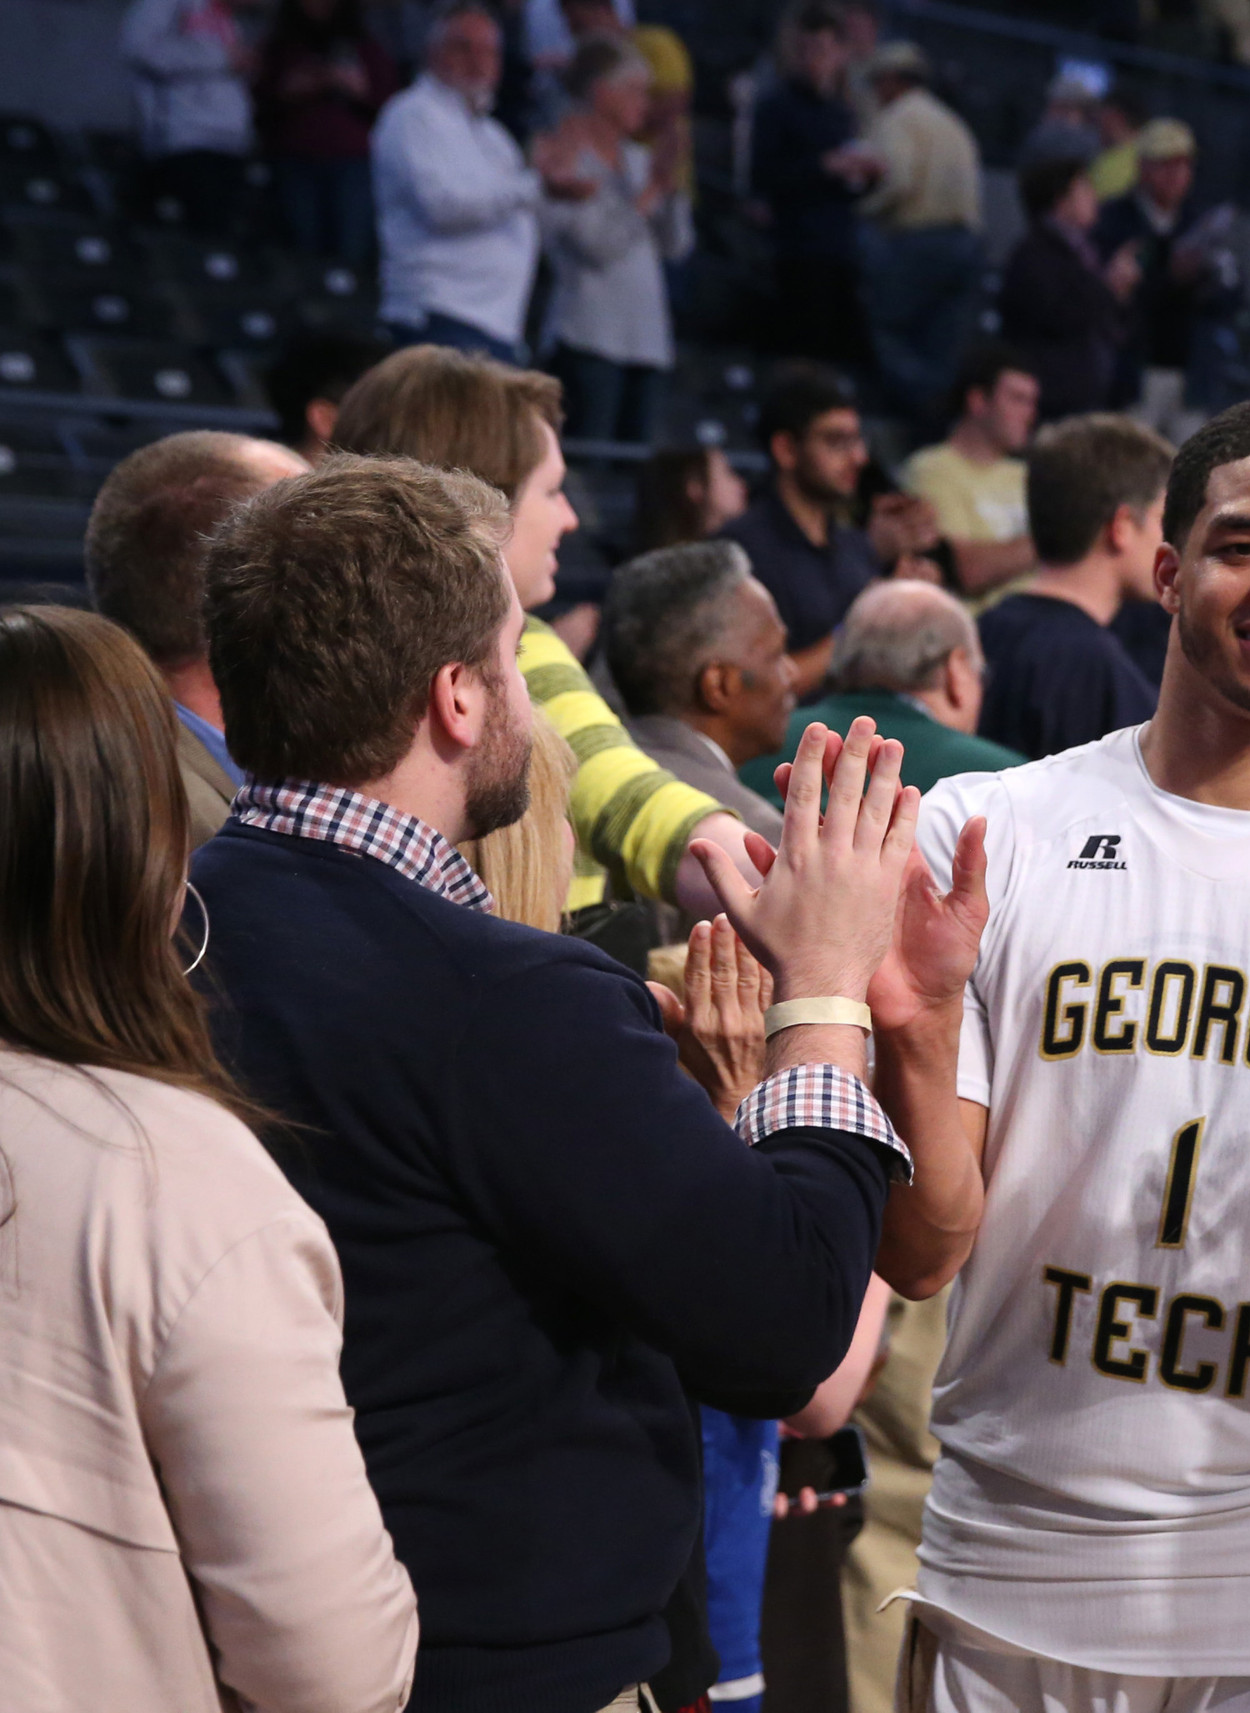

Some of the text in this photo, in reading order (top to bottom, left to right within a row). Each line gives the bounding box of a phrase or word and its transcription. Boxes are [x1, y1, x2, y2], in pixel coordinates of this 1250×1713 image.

[1079, 835, 1121, 859] R
[1067, 861, 1127, 870] RUSSELL
[1155, 1115, 1206, 1249] 1
